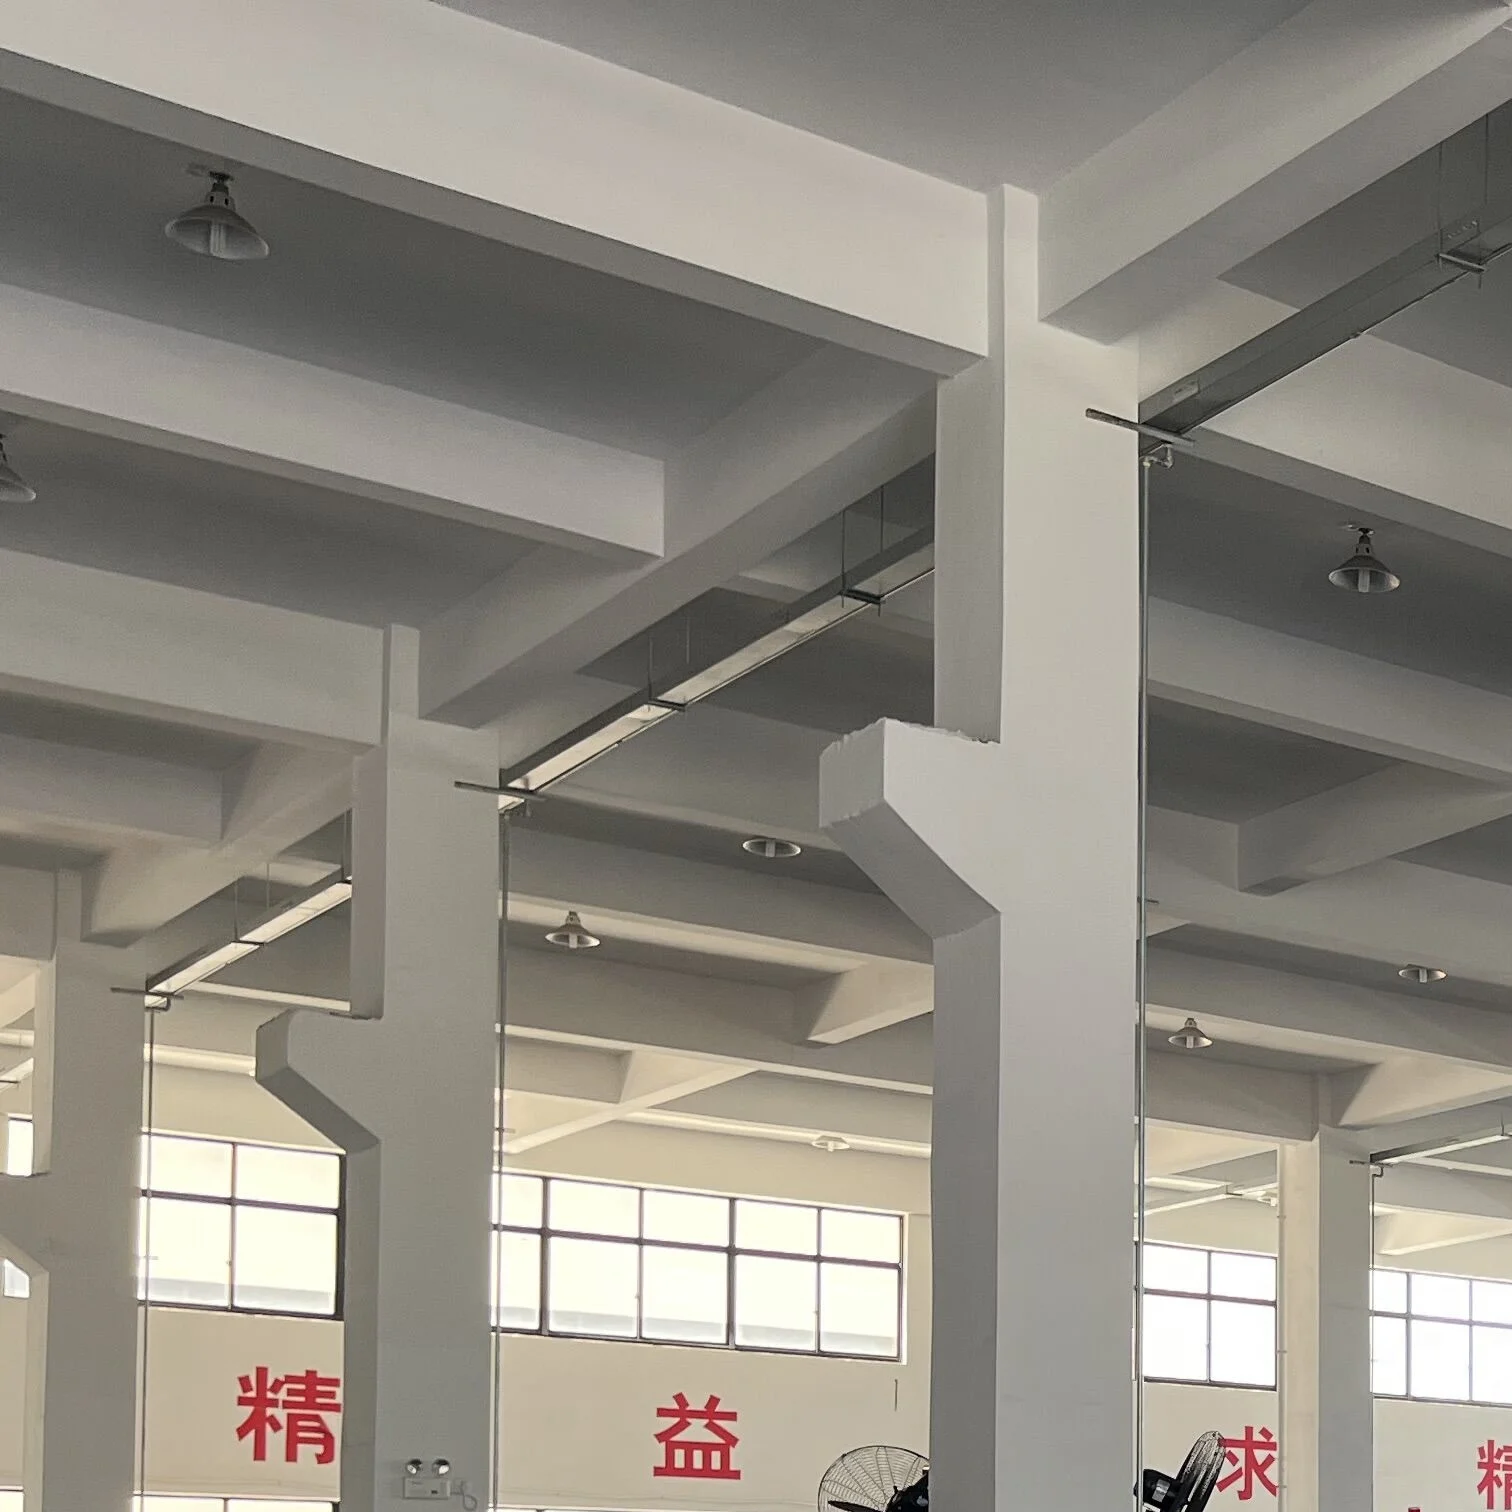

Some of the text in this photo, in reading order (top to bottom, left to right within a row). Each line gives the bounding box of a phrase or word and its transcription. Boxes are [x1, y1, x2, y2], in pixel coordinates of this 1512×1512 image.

[236, 1366, 342, 1464] 精
[653, 1391, 741, 1480] 益
[1215, 1426, 1277, 1500] 求
